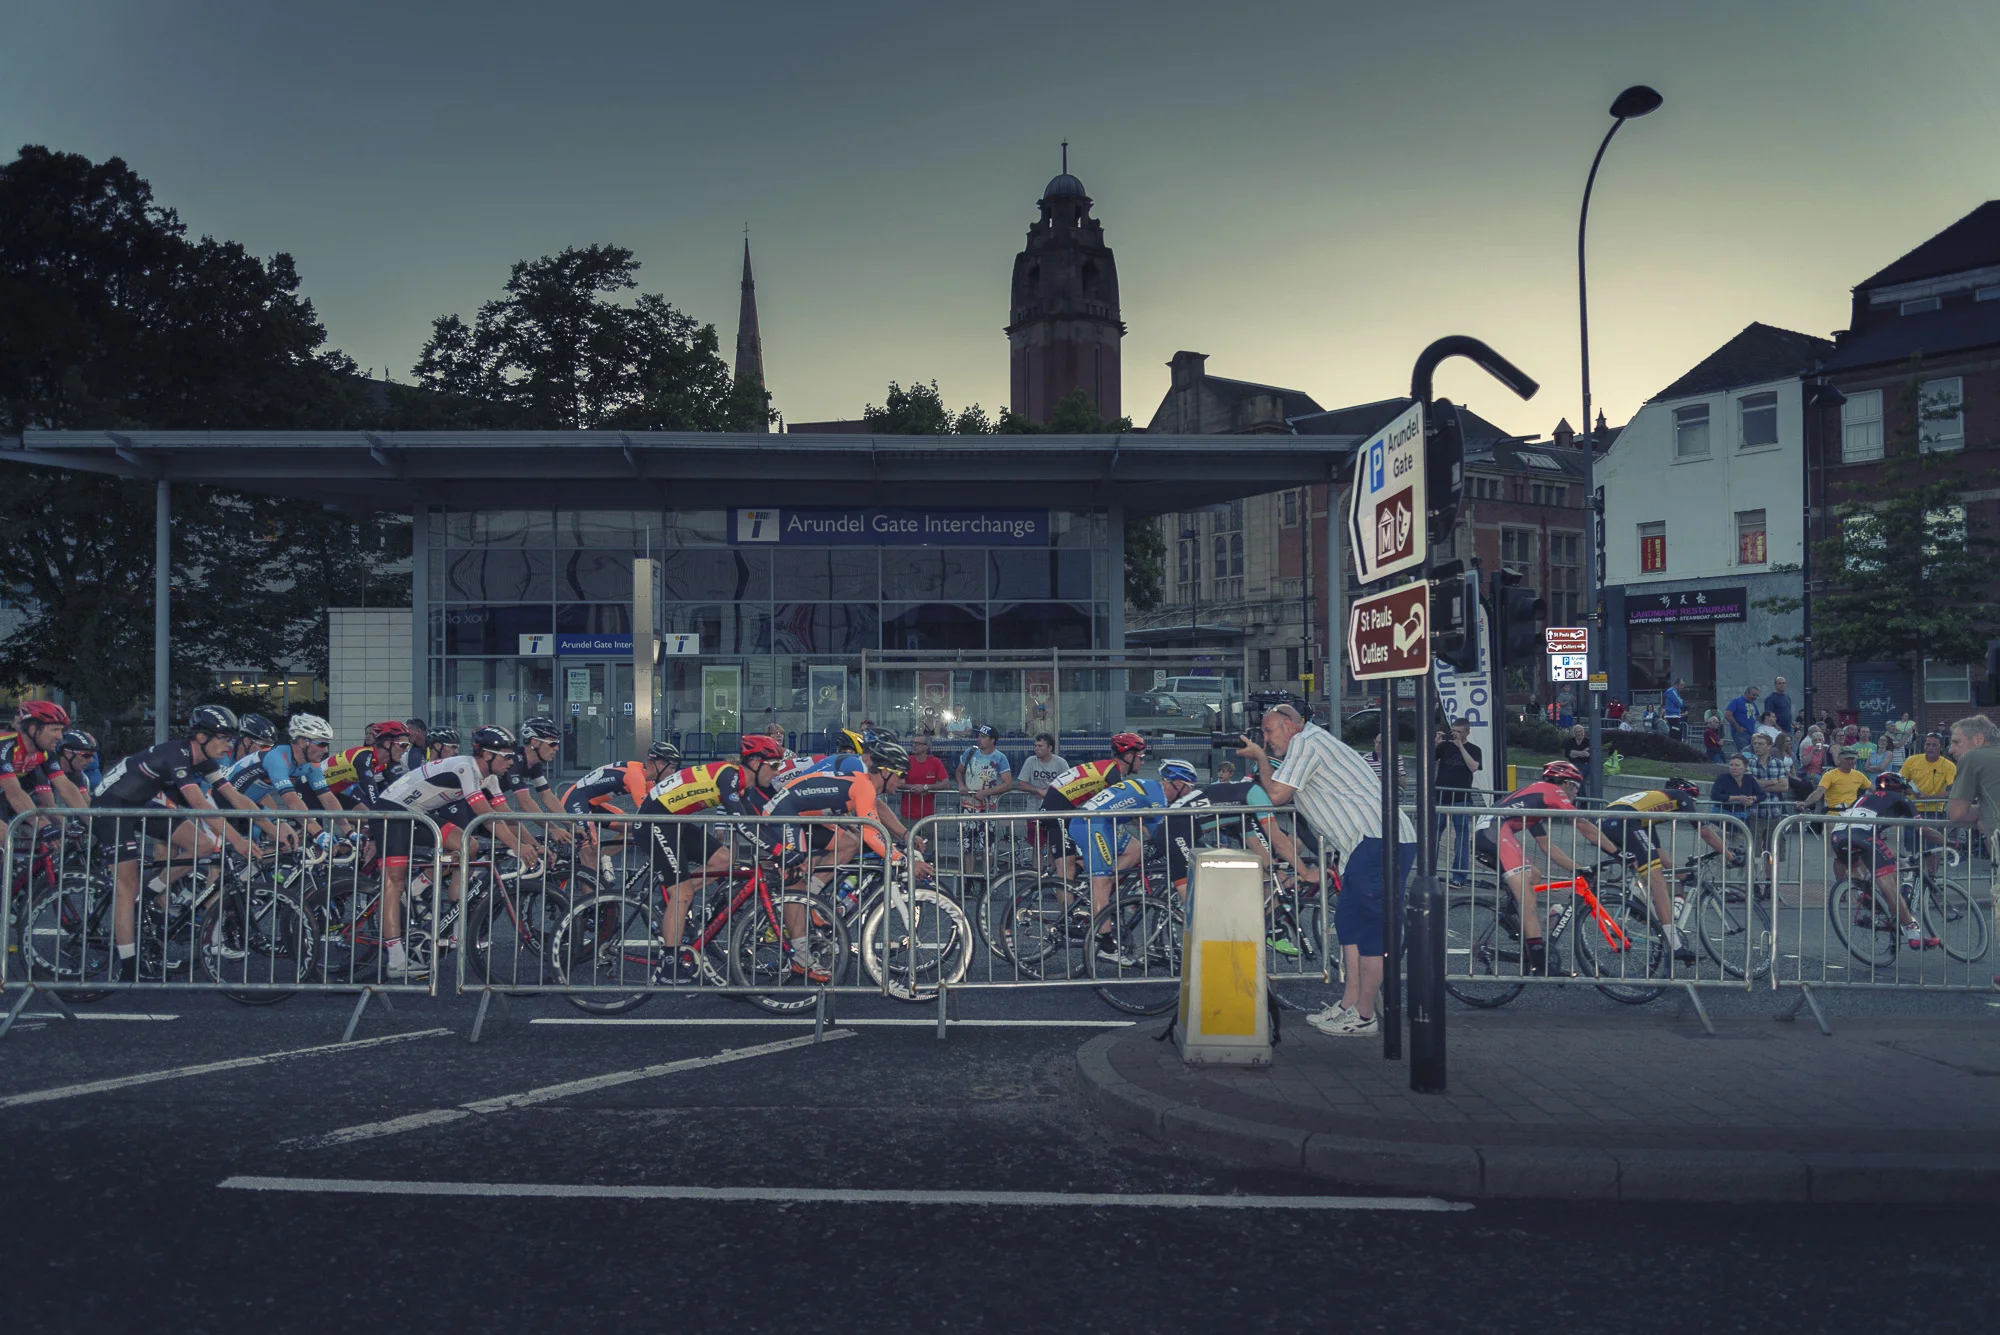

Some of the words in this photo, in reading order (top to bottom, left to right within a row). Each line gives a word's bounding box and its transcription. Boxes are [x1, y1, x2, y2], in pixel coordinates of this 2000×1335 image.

[1388, 413, 1420, 454] Arundel
[1393, 452, 1413, 478] Gate
[787, 515, 864, 532] Arundel
[872, 515, 918, 532] Gate
[925, 514, 1035, 538] Interchange
[1360, 611, 1370, 632] St
[1371, 605, 1393, 630] Pauls
[1630, 609, 1679, 619] LANDMARK
[1680, 604, 1740, 615] RESTAURANT
[562, 640, 592, 649] Arundel
[594, 640, 612, 649] Gate
[1361, 643, 1389, 665] Cutlers
[667, 787, 714, 805] RALEIGH
[794, 786, 839, 796] Velosure
[1066, 781, 1100, 796] RALEIGH
[734, 819, 770, 850] ALEIGH
[1552, 905, 1573, 938] STARLEY
[763, 995, 817, 1009] COLE
